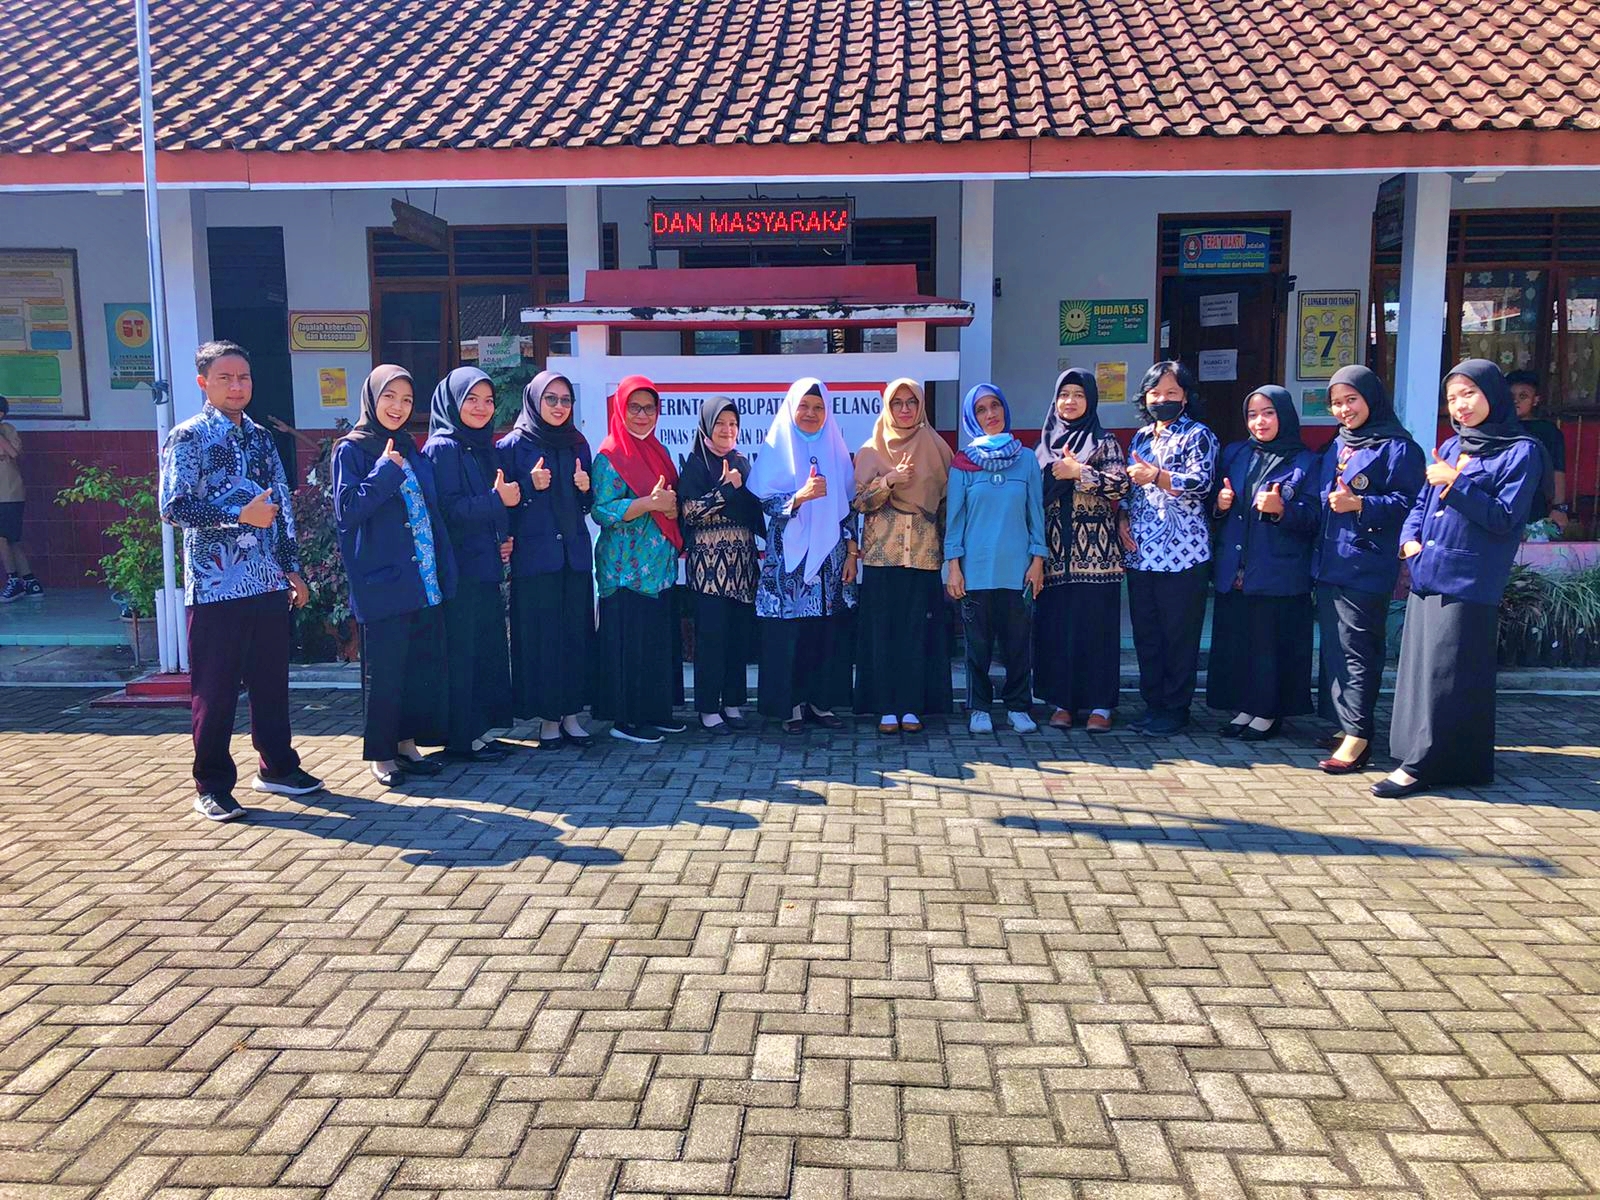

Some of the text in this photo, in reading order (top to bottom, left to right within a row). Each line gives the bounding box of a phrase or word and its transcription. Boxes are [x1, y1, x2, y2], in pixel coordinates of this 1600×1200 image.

[654, 213, 702, 233] DAN
[1093, 304, 1145, 315] BUDAYA 5S
[122, 320, 144, 337] 5T
[305, 332, 319, 340] dan
[1319, 331, 1338, 358] 7
[832, 397, 881, 415] ELANG
[660, 429, 689, 445] DINAS
